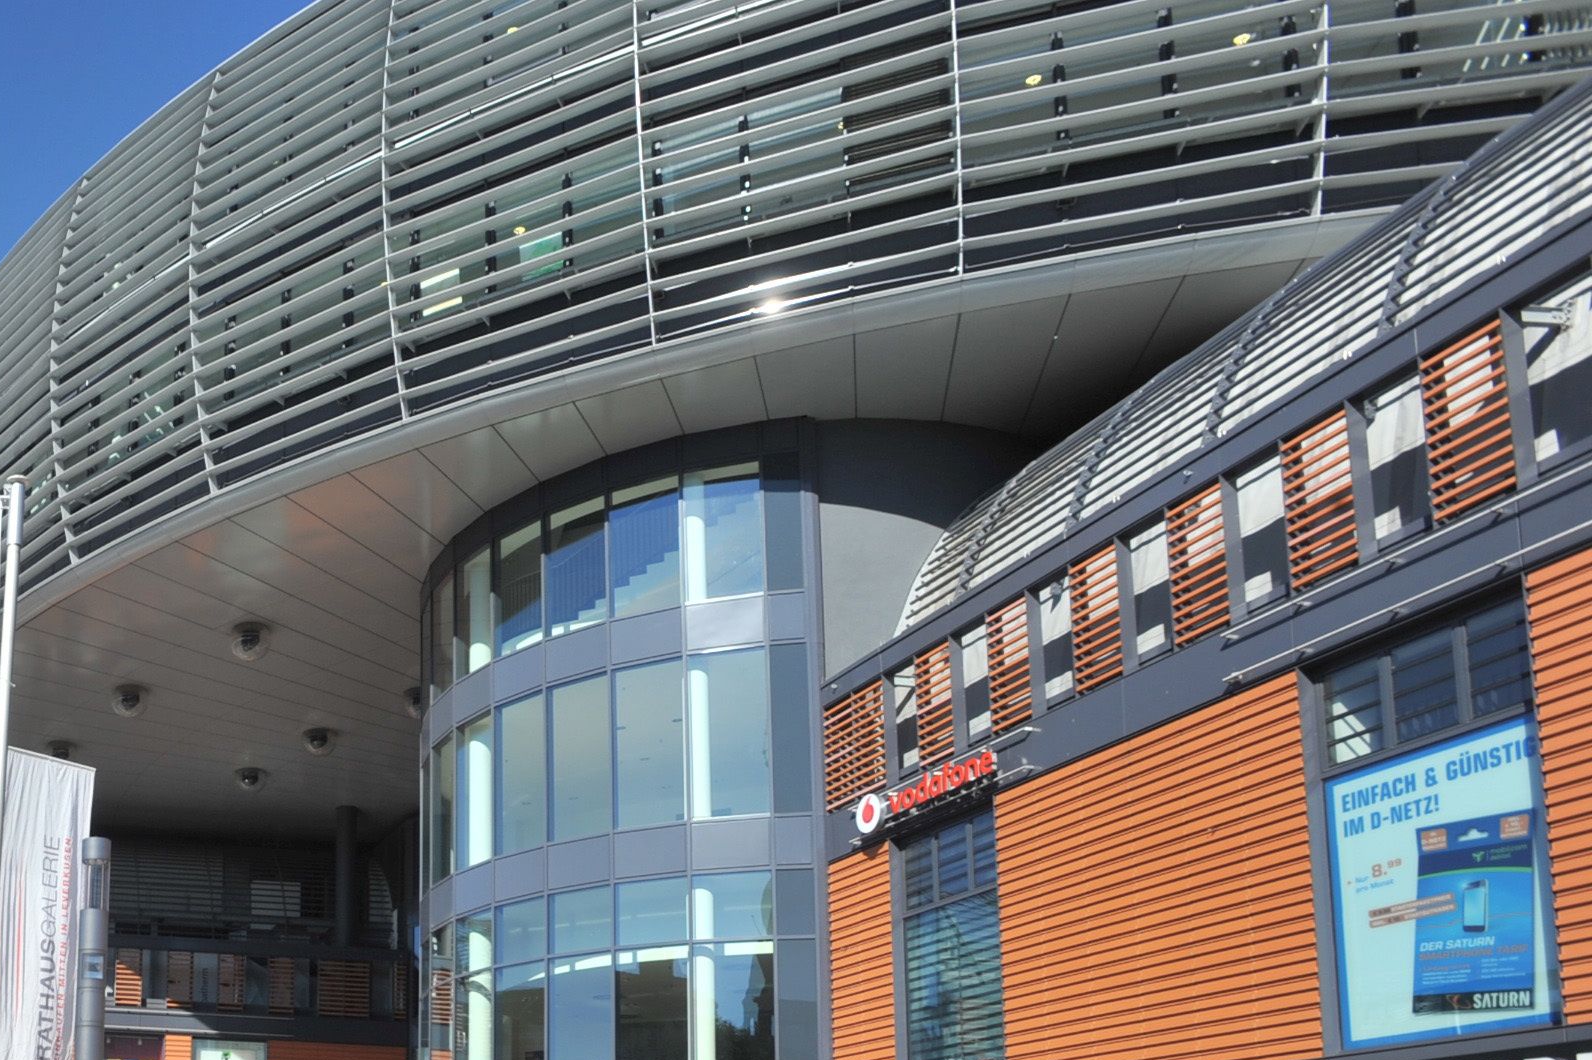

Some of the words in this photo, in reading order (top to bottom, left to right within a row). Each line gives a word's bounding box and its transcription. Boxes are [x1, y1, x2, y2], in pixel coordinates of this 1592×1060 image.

[888, 751, 996, 814] vodafone
[1341, 773, 1417, 813] EINFACH
[1424, 767, 1438, 788] &
[1343, 819, 1365, 838] IM
[1370, 794, 1440, 830] D-NETZ!
[61, 836, 72, 918] LEVERKUSEN
[59, 941, 69, 988] MITTEN
[1419, 940, 1444, 952] DER
[1446, 936, 1496, 950] SATURN
[1472, 990, 1531, 1009] SATURN
